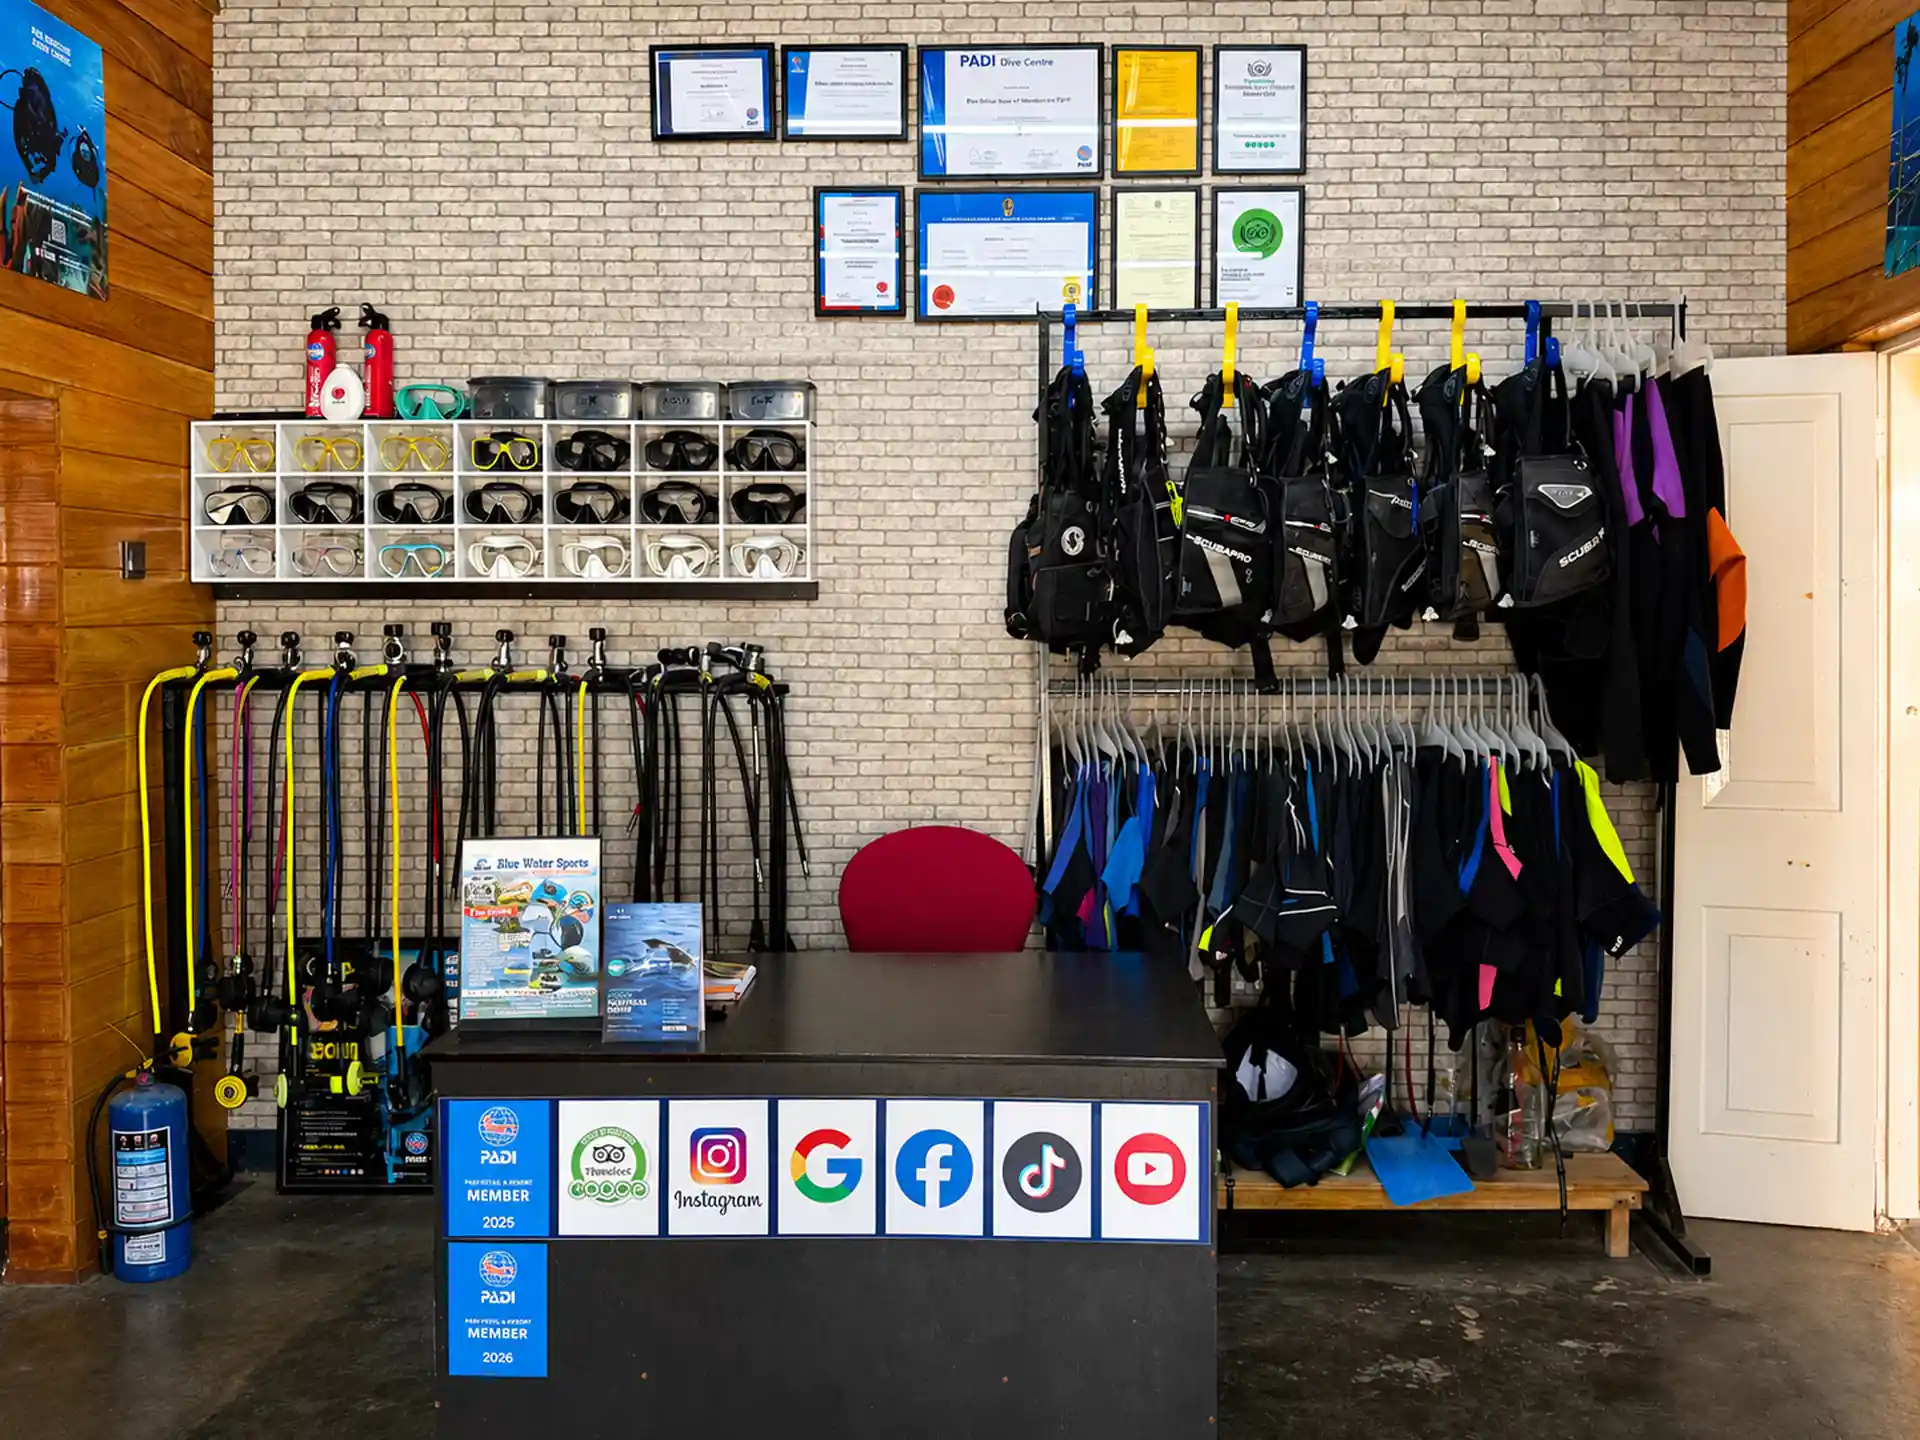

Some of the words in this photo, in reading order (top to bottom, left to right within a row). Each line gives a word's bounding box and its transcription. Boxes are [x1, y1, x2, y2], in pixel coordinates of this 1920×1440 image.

[960, 54, 996, 68] PADI
[1000, 57, 1022, 67] Dive
[1024, 57, 1054, 67] Centre
[1191, 535, 1252, 564] SCUBAPRO
[496, 858, 520, 870] Blue
[523, 858, 554, 869] Water
[556, 857, 589, 871] Sports
[480, 1150, 517, 1165] PADI
[467, 1188, 530, 1202] MEMBER
[673, 1190, 763, 1216] Instagram
[480, 1290, 516, 1304] PADI
[467, 1327, 528, 1340] MEMBER
[482, 1352, 514, 1364] 2026
